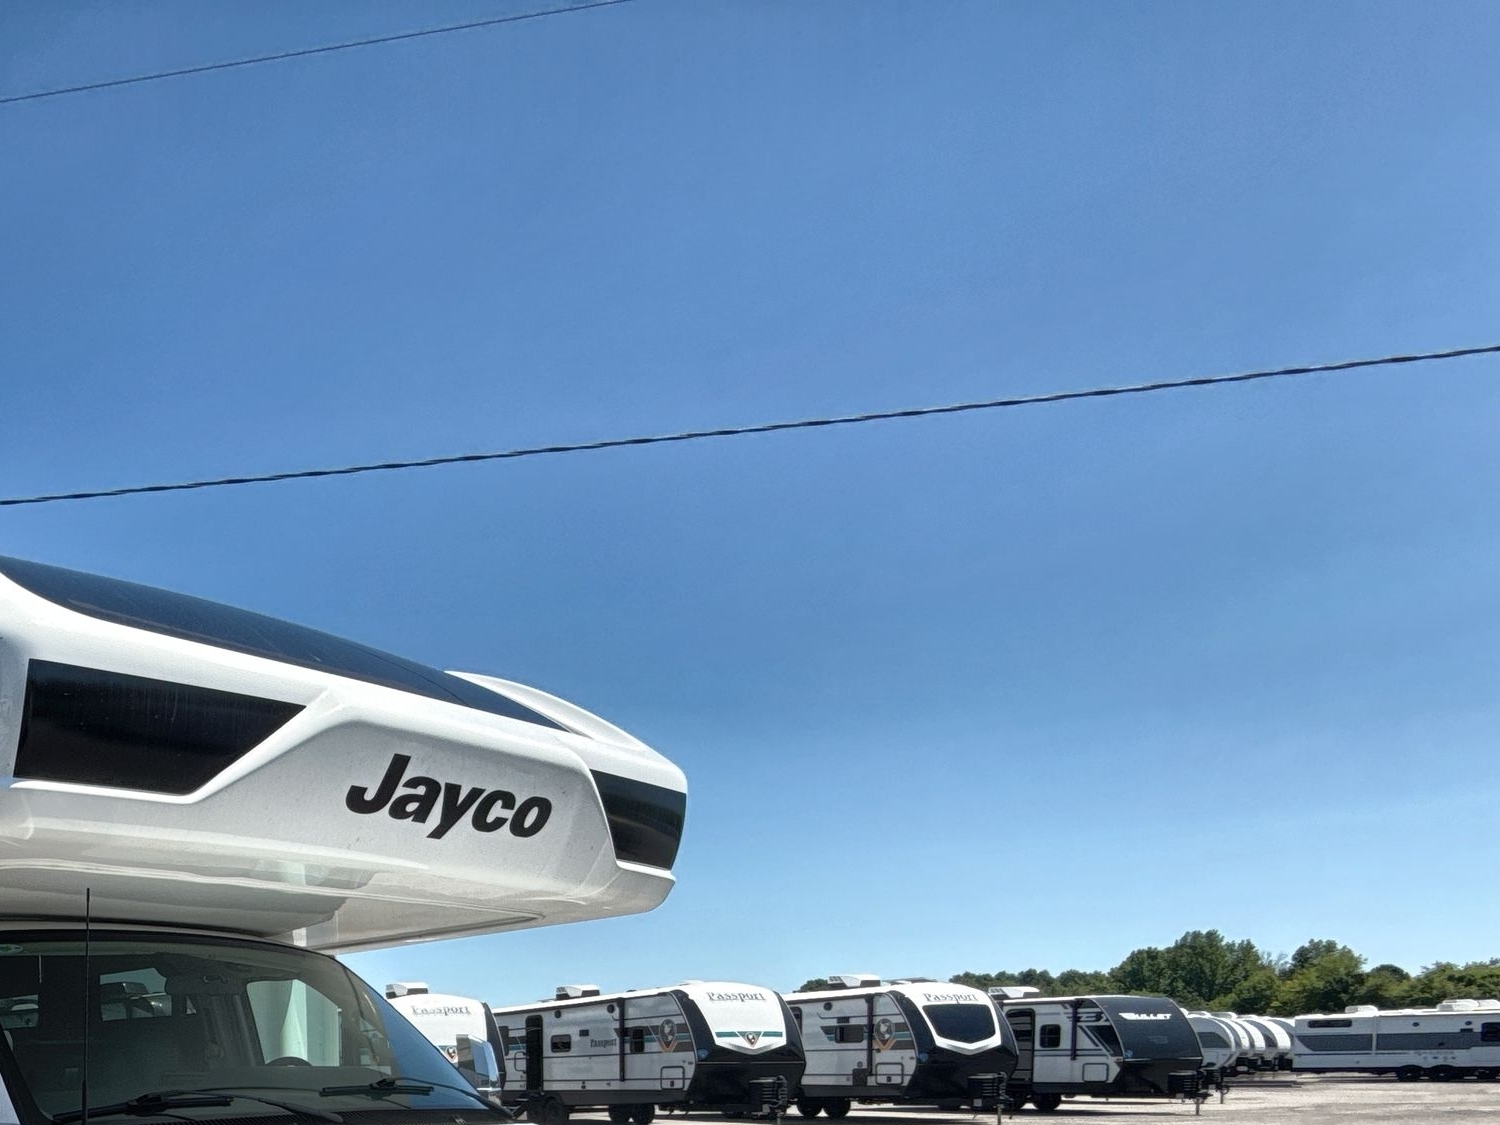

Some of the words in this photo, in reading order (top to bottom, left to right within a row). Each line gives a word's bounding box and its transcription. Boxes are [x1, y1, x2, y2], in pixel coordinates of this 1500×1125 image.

[345, 753, 552, 839] Jayco
[707, 992, 766, 1002] Passport
[924, 993, 979, 1004] Passport
